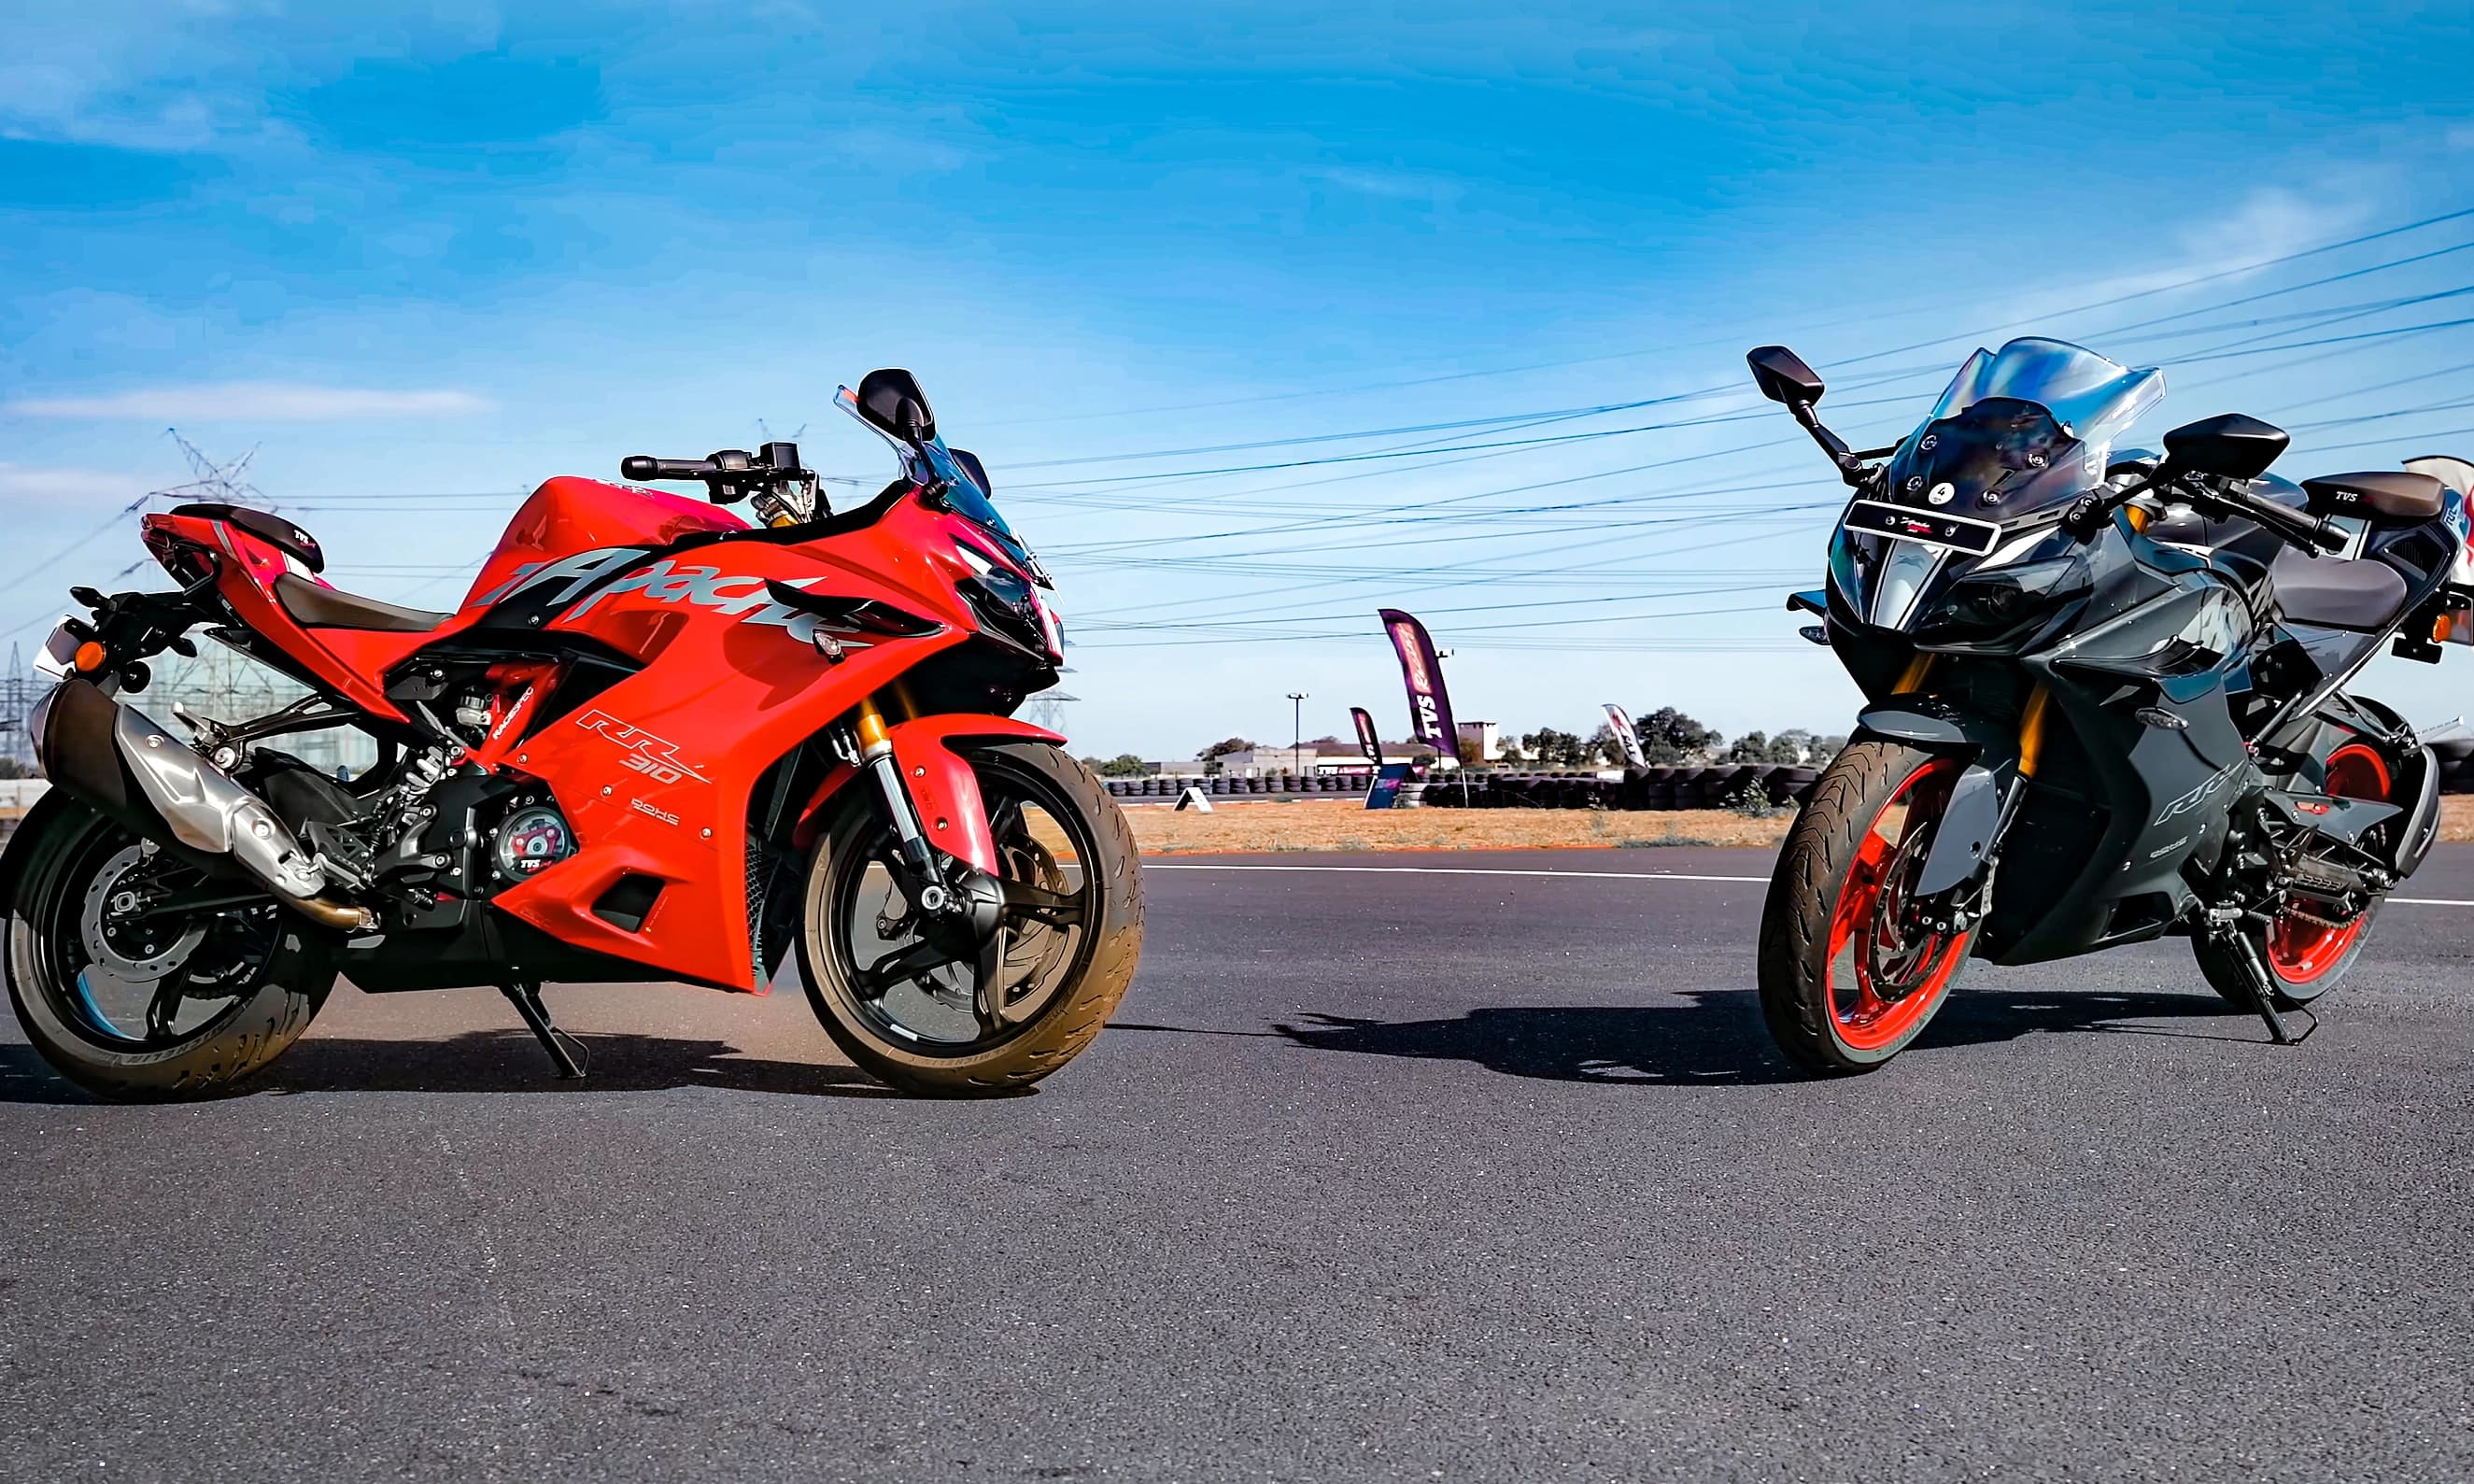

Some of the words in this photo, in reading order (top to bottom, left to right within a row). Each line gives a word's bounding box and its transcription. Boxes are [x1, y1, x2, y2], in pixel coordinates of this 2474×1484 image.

[2336, 490, 2358, 502] TVS
[294, 530, 309, 544] TVS
[492, 685, 534, 741] RACESPEC
[1417, 695, 1443, 739] TVS
[575, 709, 712, 784] RR
[618, 753, 682, 784] 310
[630, 798, 681, 823] DOHC
[520, 859, 541, 869] TVS
